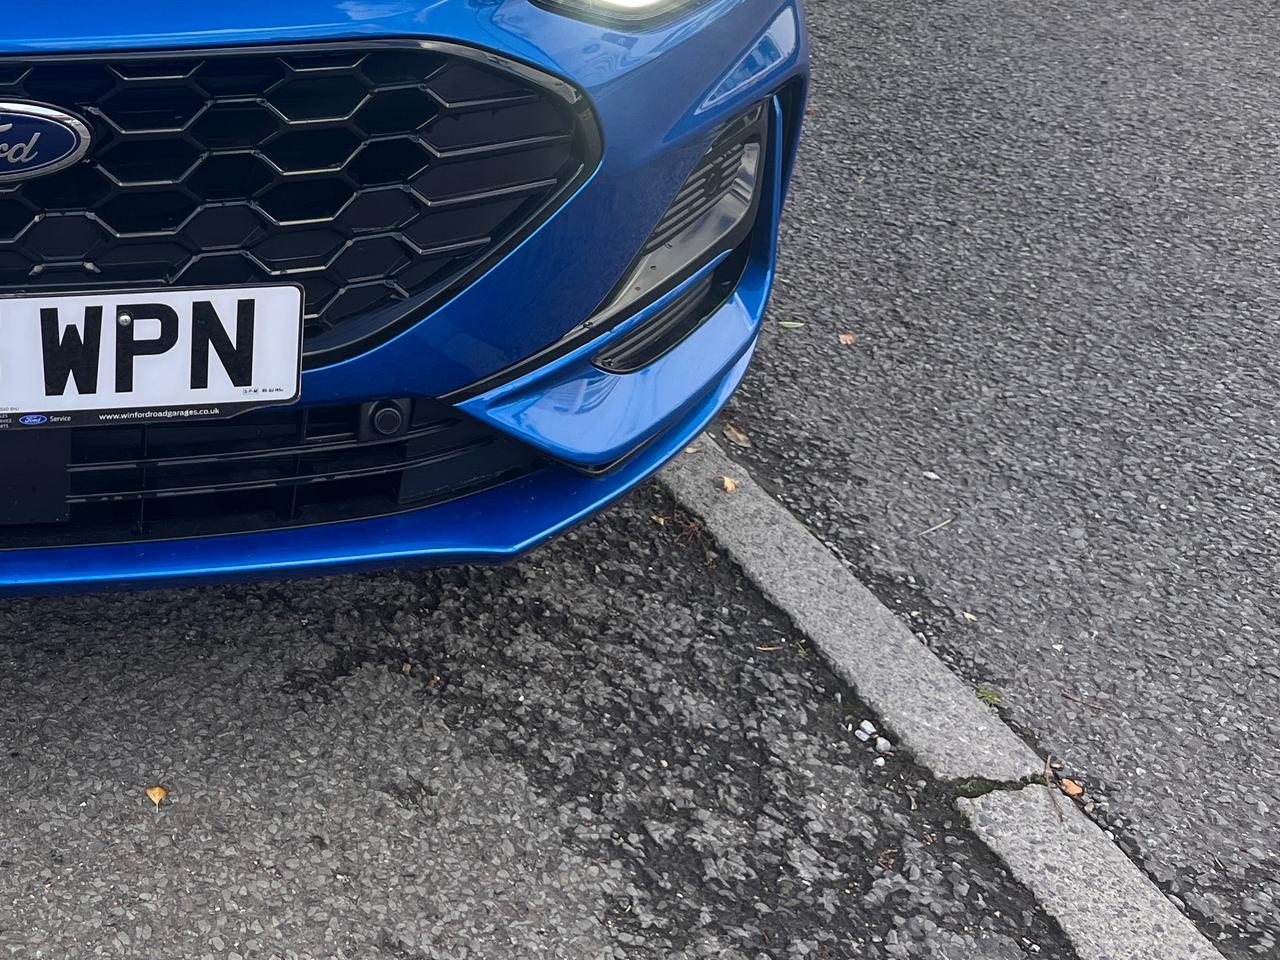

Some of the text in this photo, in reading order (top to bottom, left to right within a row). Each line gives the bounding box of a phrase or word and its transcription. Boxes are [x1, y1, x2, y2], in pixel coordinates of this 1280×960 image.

[39, 299, 256, 397] WPN
[49, 415, 72, 423] Service
[98, 407, 220, 421] www.winfordroadgarages.co.uk
